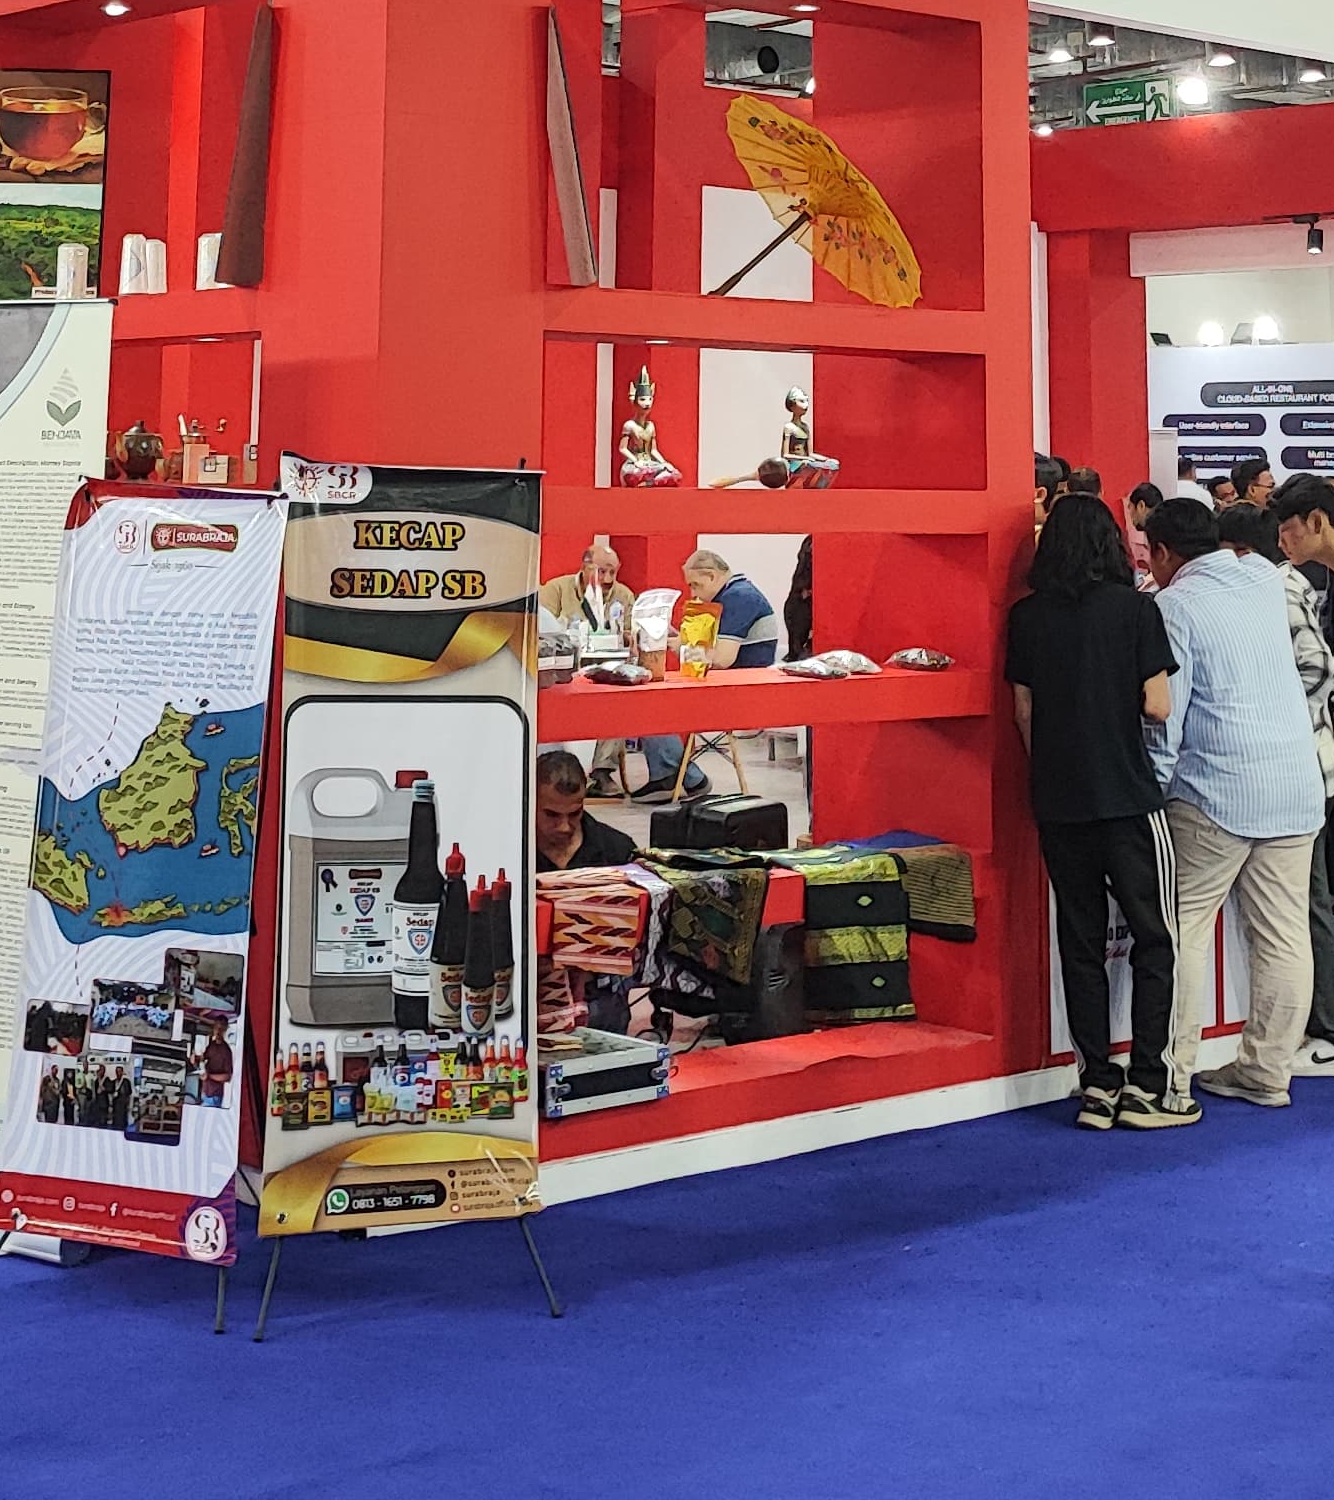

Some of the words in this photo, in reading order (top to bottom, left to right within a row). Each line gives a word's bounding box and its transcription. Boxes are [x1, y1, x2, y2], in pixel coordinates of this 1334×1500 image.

[176, 531, 237, 545] SURABRAJA
[354, 521, 465, 550] KECAP
[330, 568, 437, 598] SEDAP
[442, 570, 487, 599] SB
[405, 916, 435, 928] Sedap
[462, 1189, 500, 1199] surabraja
